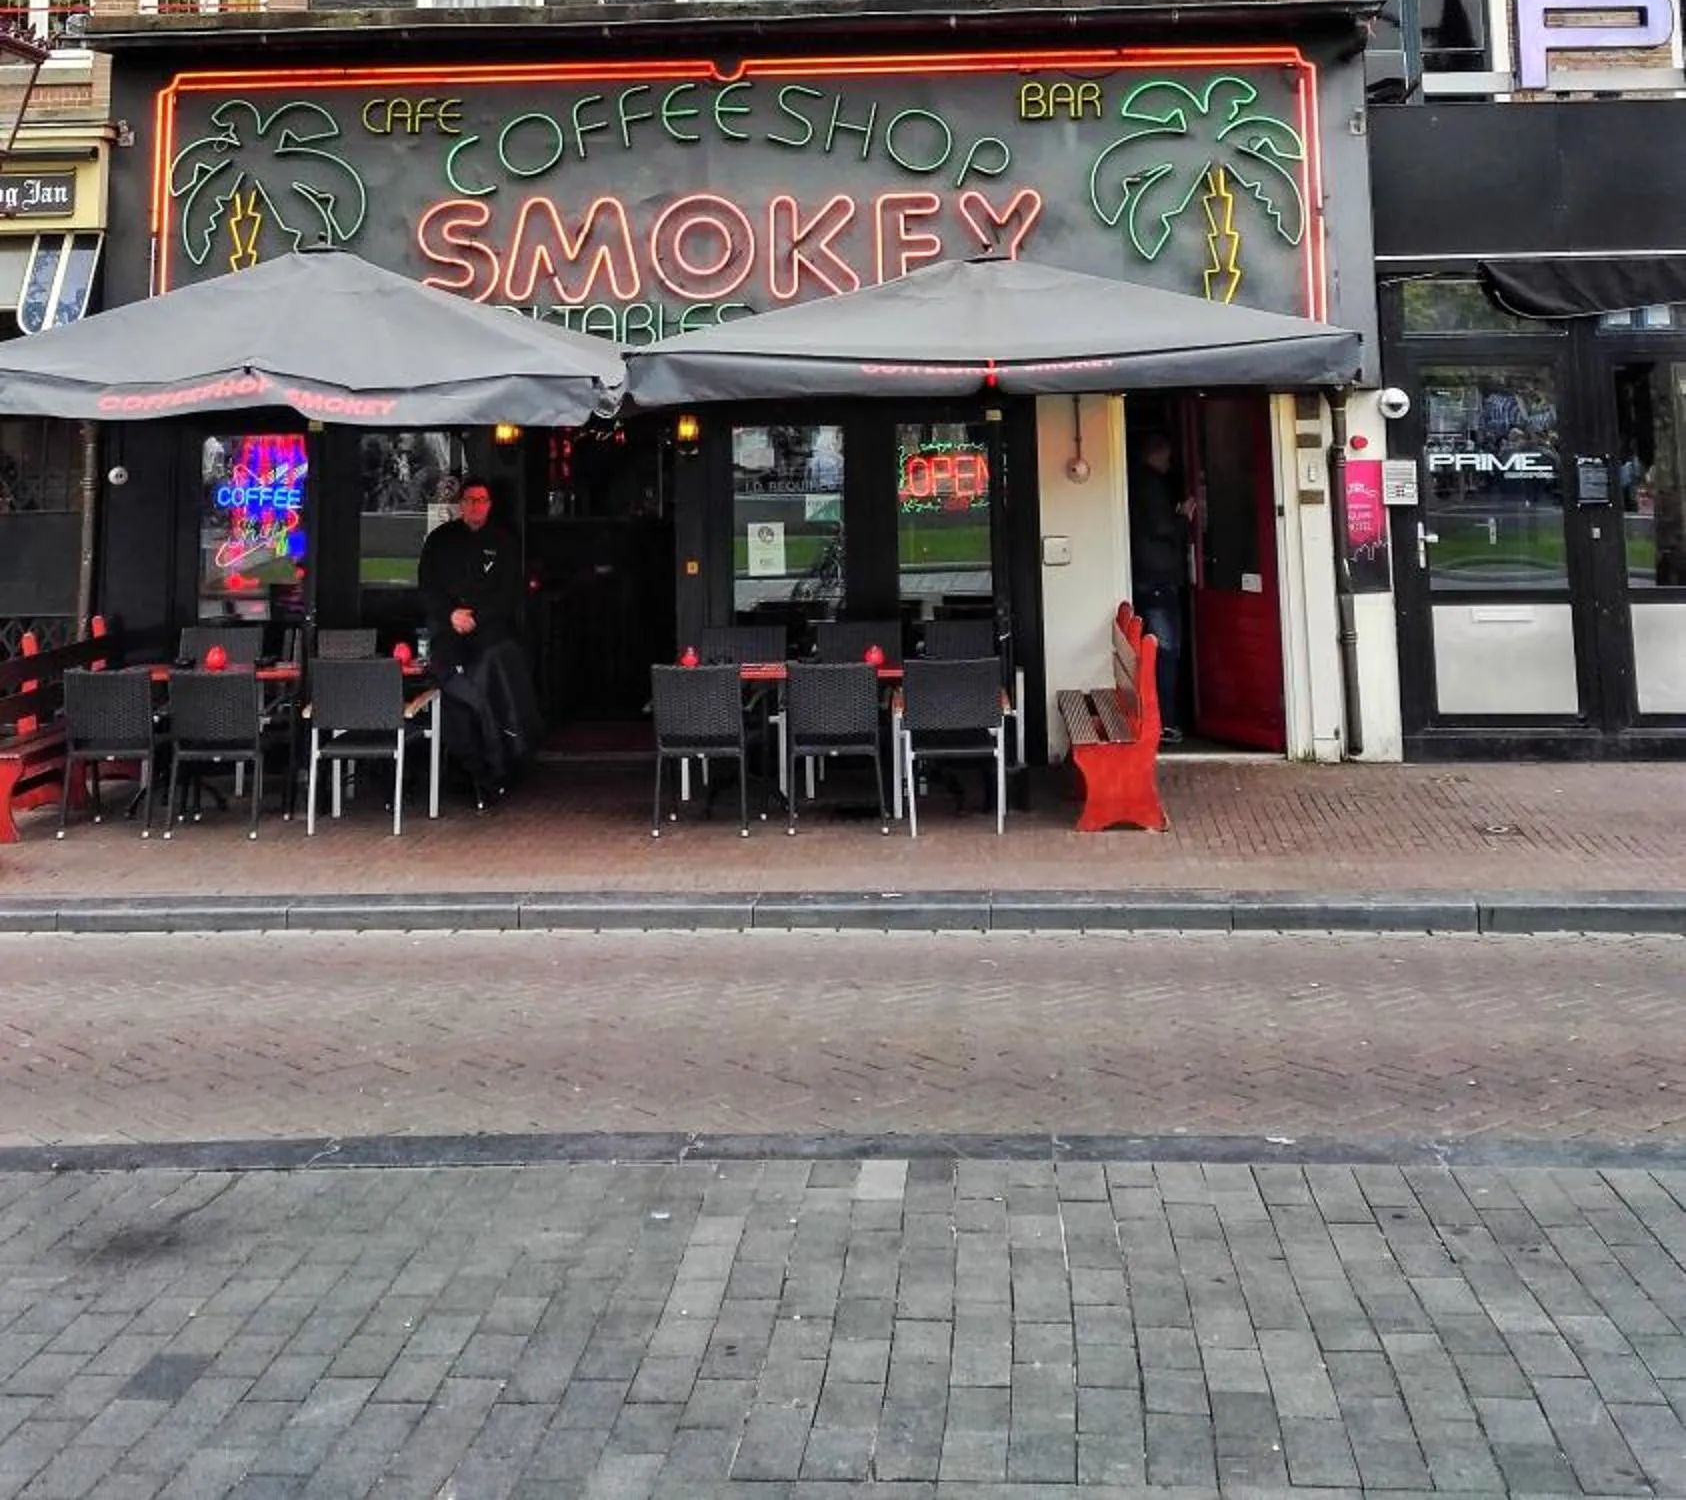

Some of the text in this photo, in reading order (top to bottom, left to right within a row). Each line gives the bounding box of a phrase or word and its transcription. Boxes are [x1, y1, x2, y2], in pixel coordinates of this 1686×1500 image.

[363, 98, 465, 134] CAFE
[1020, 82, 1103, 120] BAR
[22, 179, 68, 211] Jan
[417, 188, 1042, 303] SMOKEY
[1429, 453, 1553, 471] PRIME
[217, 486, 303, 508] COFFEE
